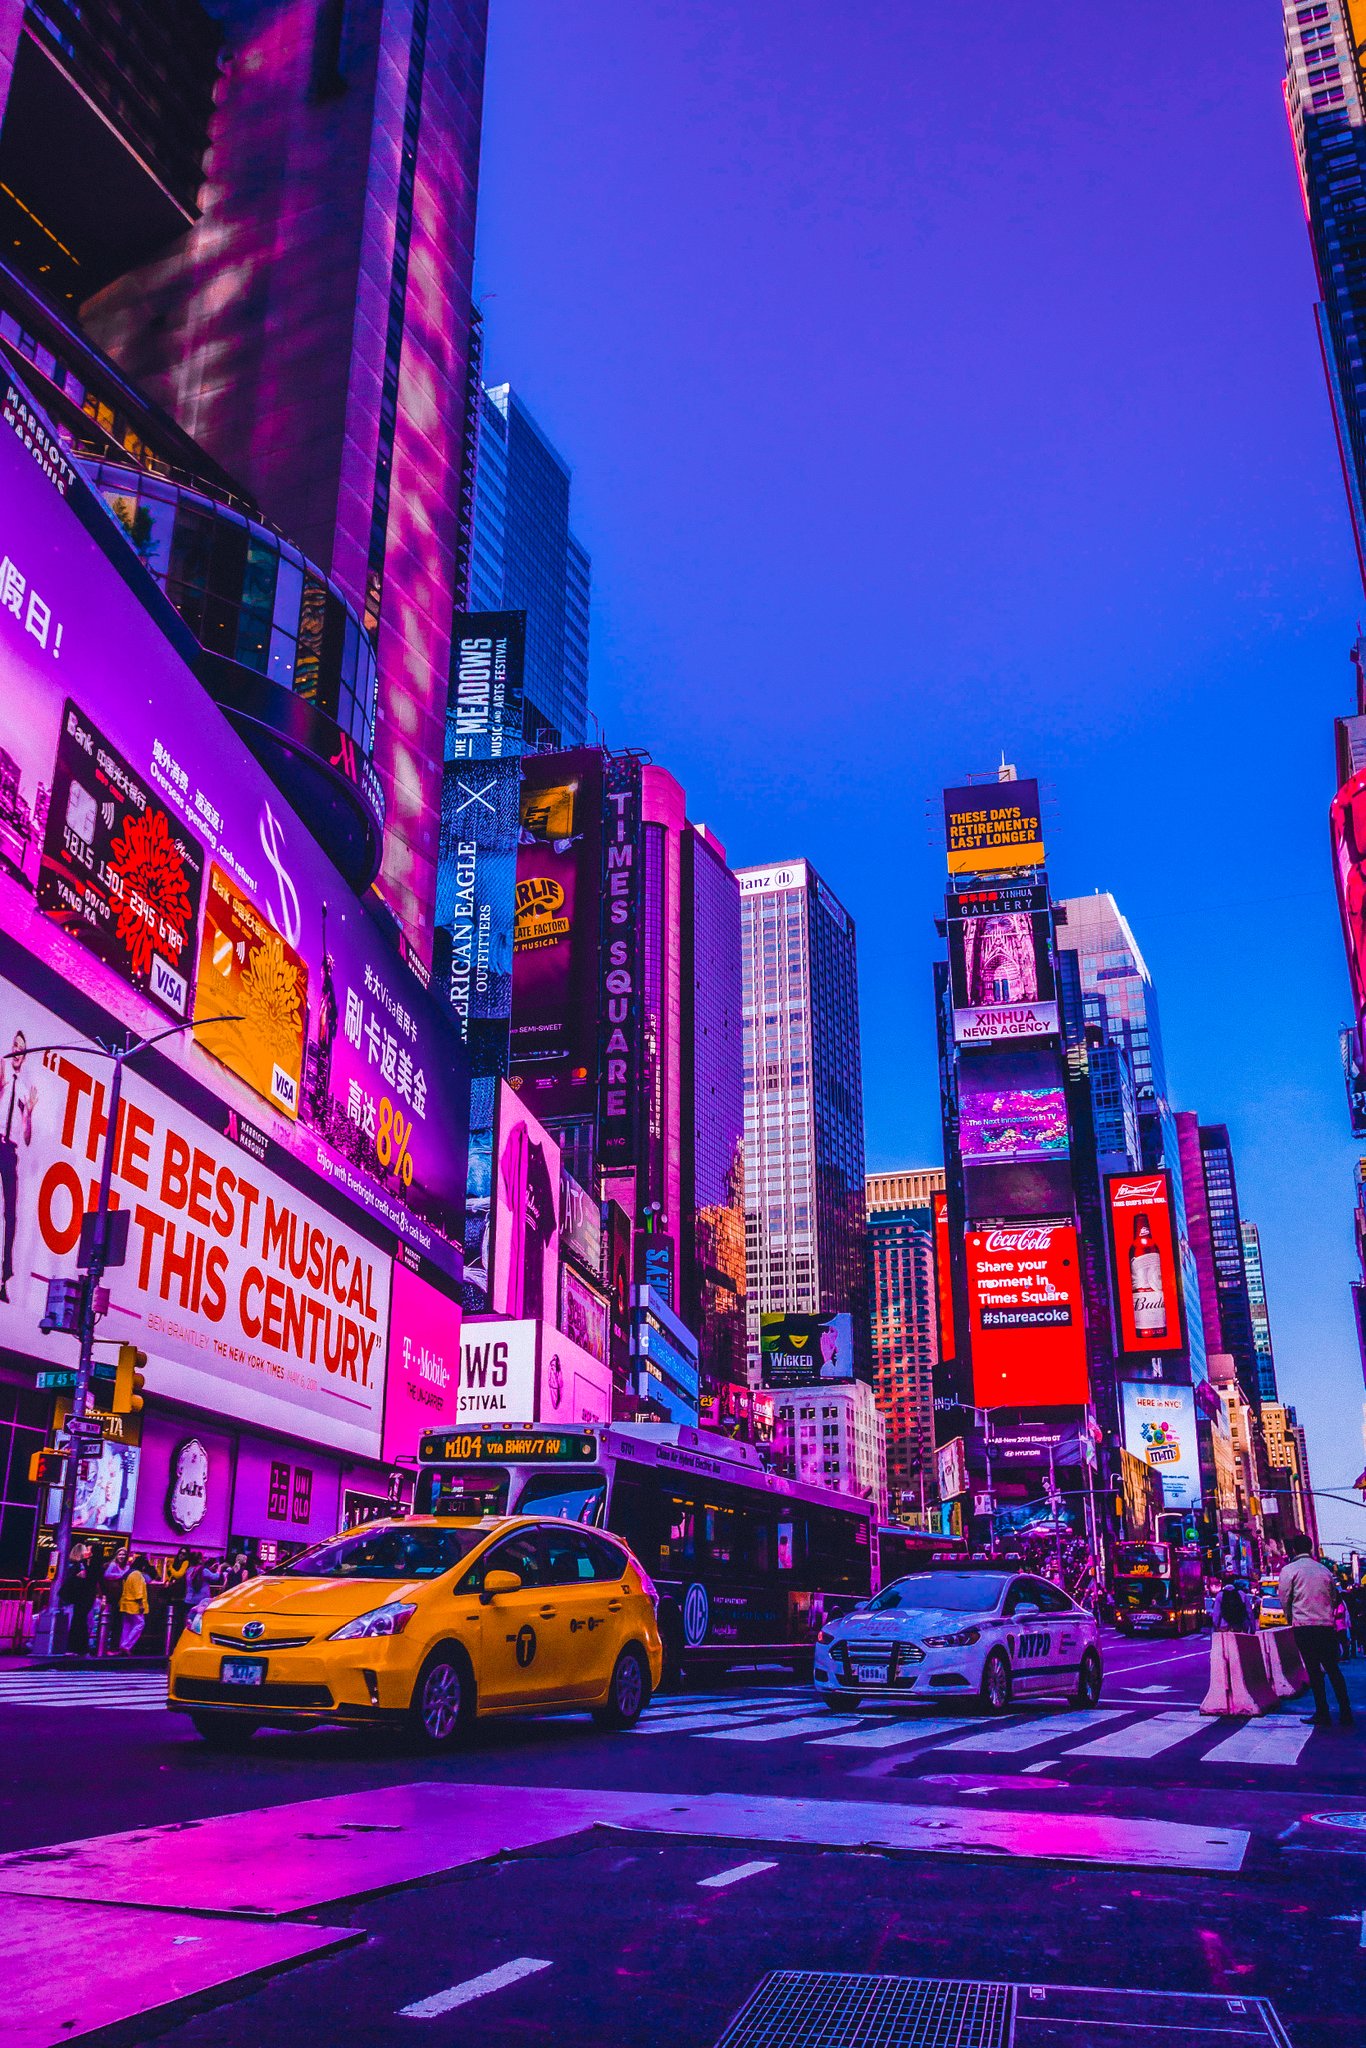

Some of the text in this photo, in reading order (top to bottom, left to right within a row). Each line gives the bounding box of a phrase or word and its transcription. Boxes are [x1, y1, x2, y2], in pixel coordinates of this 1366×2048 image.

[7, 386, 76, 486] MARRIOTT
[496, 636, 508, 681] FESTIVAL
[454, 636, 493, 758] THE MEADOWS
[495, 683, 505, 710] ARTS
[491, 724, 503, 758] MUSIC
[150, 761, 185, 809] Overseas
[185, 804, 217, 849] spending
[950, 807, 1021, 825] THESE DAYS
[950, 818, 1038, 838] RETIREMENTS
[951, 830, 1036, 850] LAST LONGER
[63, 825, 183, 954] 4815 1301 2345 6789
[457, 840, 477, 914] EAGLE
[57, 880, 82, 913] YANG
[84, 888, 111, 920] 00/00
[999, 888, 1033, 899] XINHUA
[961, 899, 1033, 914] GALLERY
[533, 919, 567, 936] FACTORY
[475, 903, 491, 993] OUTFITTERS
[521, 937, 558, 951] MUSICAL
[605, 791, 633, 1116] TIMES SQUARE
[155, 963, 182, 1006] VISA
[519, 1023, 563, 1033] SEMI-SWEET
[963, 1020, 1051, 1038] NEWS AGENCY
[976, 1009, 1037, 1026] XINHUA
[344, 986, 428, 1120] 刷卡返美金
[274, 1070, 294, 1104] VISA
[983, 1117, 1000, 1125] Next
[239, 1133, 265, 1159] MARQUIS
[240, 1121, 269, 1148] MARRIOTT
[606, 1137, 626, 1146] NYC
[316, 1147, 334, 1175] Enjoy
[334, 1164, 347, 1183] with
[347, 1172, 375, 1207] Everbright
[375, 1197, 390, 1217] credit
[389, 1208, 400, 1225] card
[409, 1224, 419, 1241] cash
[160, 1128, 260, 1249] BEST
[262, 1195, 378, 1323] MUSICAL
[985, 1227, 1054, 1252] Coca-Cola
[134, 1203, 230, 1322] THIS
[976, 1260, 1048, 1273] Share your
[977, 1274, 1049, 1289] moment in
[978, 1291, 1069, 1304] Times Square
[983, 1309, 1069, 1324] #shareacoke
[147, 1313, 165, 1334] BEN
[167, 1321, 210, 1349] BRANTLEY
[213, 1339, 227, 1357] THE
[228, 1346, 246, 1364] NEW
[247, 1354, 265, 1371] YORK
[266, 1361, 285, 1379] TIMES
[57, 1373, 67, 1385] 45
[1137, 1398, 1155, 1406] HERE
[445, 1435, 561, 1458] M104 VIA BWAY/7 AV
[656, 1447, 670, 1460] Clean
[679, 1454, 695, 1467] Hybrid
[295, 1470, 310, 1494] UNI
[292, 1497, 309, 1520] QLO
[1018, 1632, 1051, 1659] NYPD
